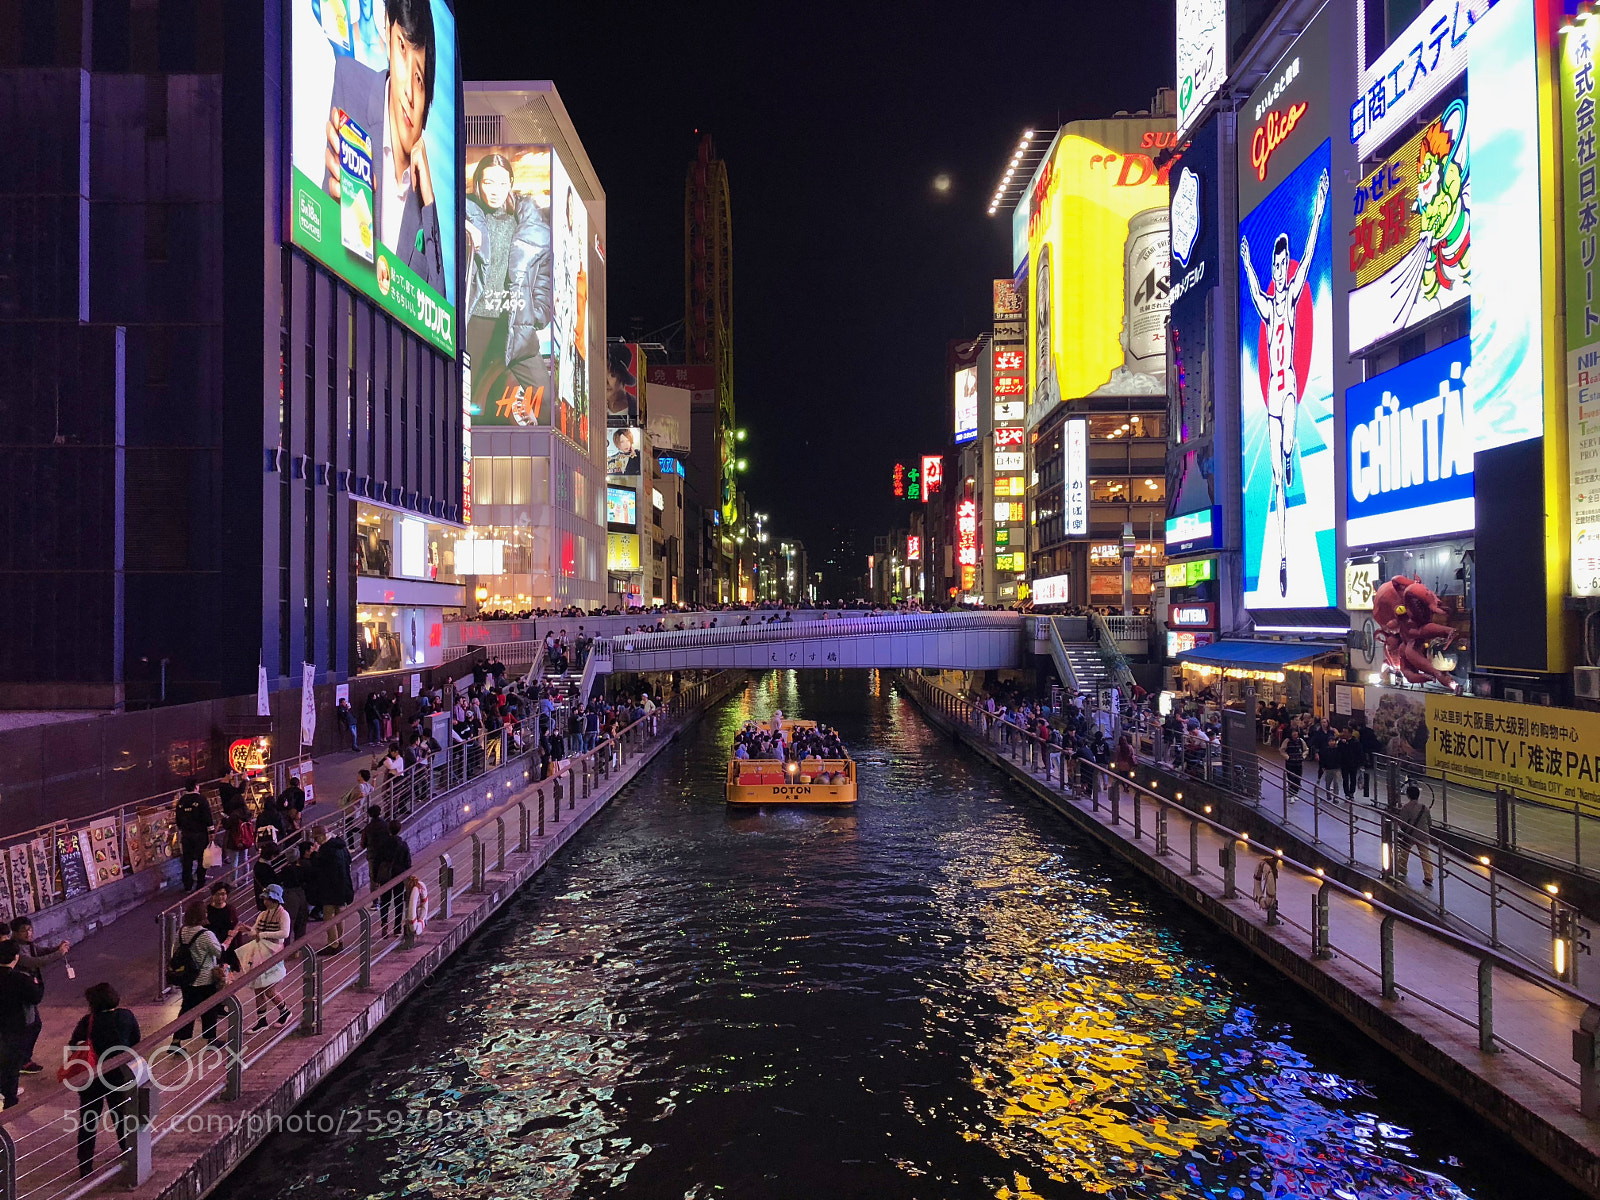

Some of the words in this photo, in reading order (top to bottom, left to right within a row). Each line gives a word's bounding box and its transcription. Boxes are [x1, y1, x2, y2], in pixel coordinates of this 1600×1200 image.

[1251, 101, 1307, 181] Glico
[417, 288, 452, 346] サロンパス
[484, 299, 527, 313] ¥7,499
[1276, 318, 1285, 392] グリコ
[773, 786, 811, 795] DOTON
